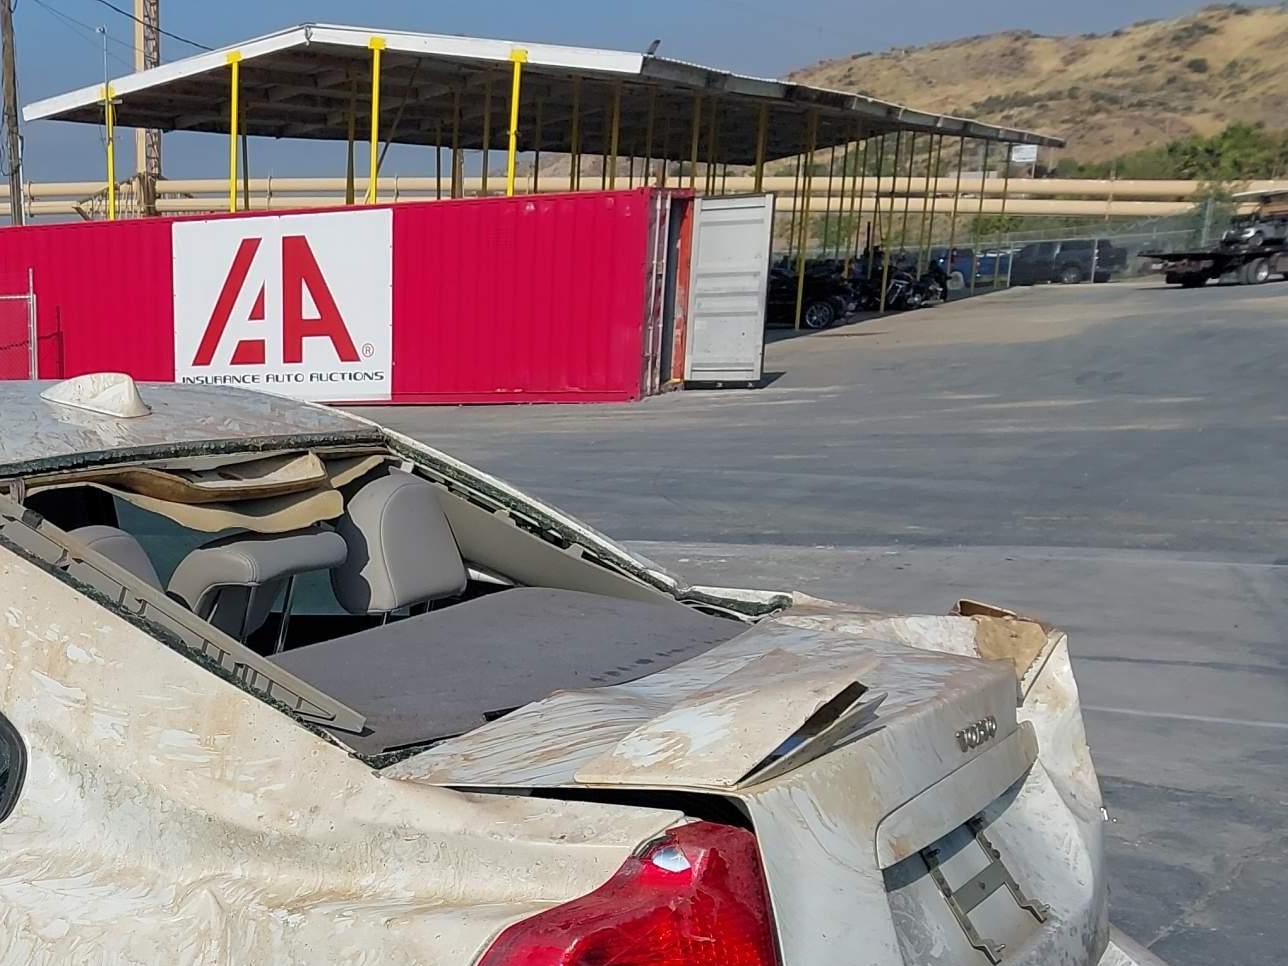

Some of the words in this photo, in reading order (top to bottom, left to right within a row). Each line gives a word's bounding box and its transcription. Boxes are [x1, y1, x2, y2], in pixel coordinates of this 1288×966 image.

[182, 374, 261, 385] INSURANCE
[265, 373, 305, 384] AUTO
[309, 371, 385, 383] AUCTIONS
